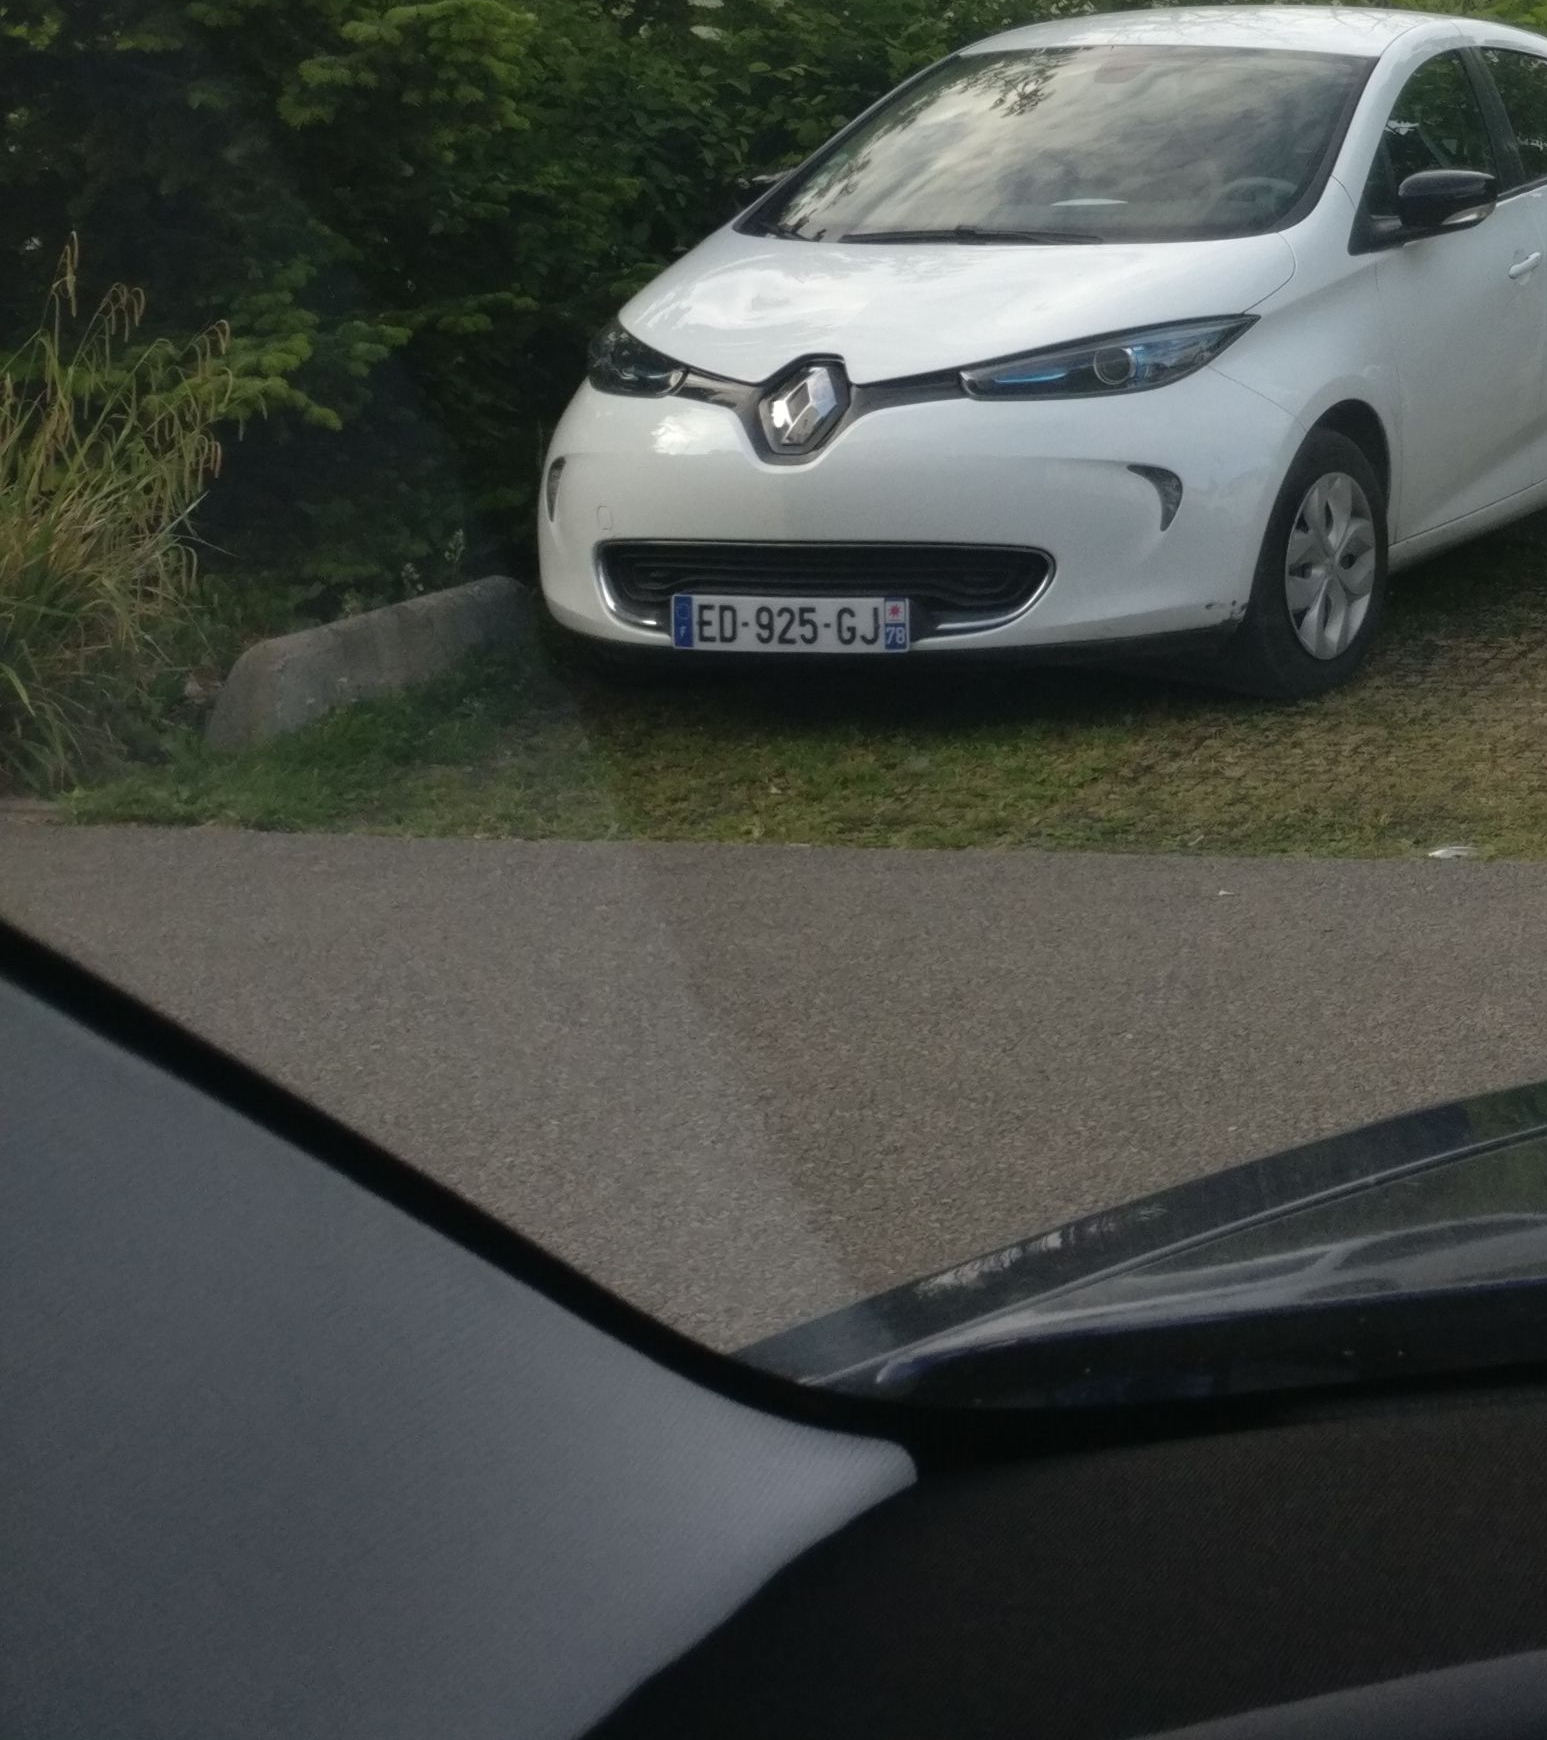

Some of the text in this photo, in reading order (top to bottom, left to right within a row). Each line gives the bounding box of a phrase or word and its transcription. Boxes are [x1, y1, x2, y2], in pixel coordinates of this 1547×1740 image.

[678, 603, 906, 646] F ED-925-GJ 78
